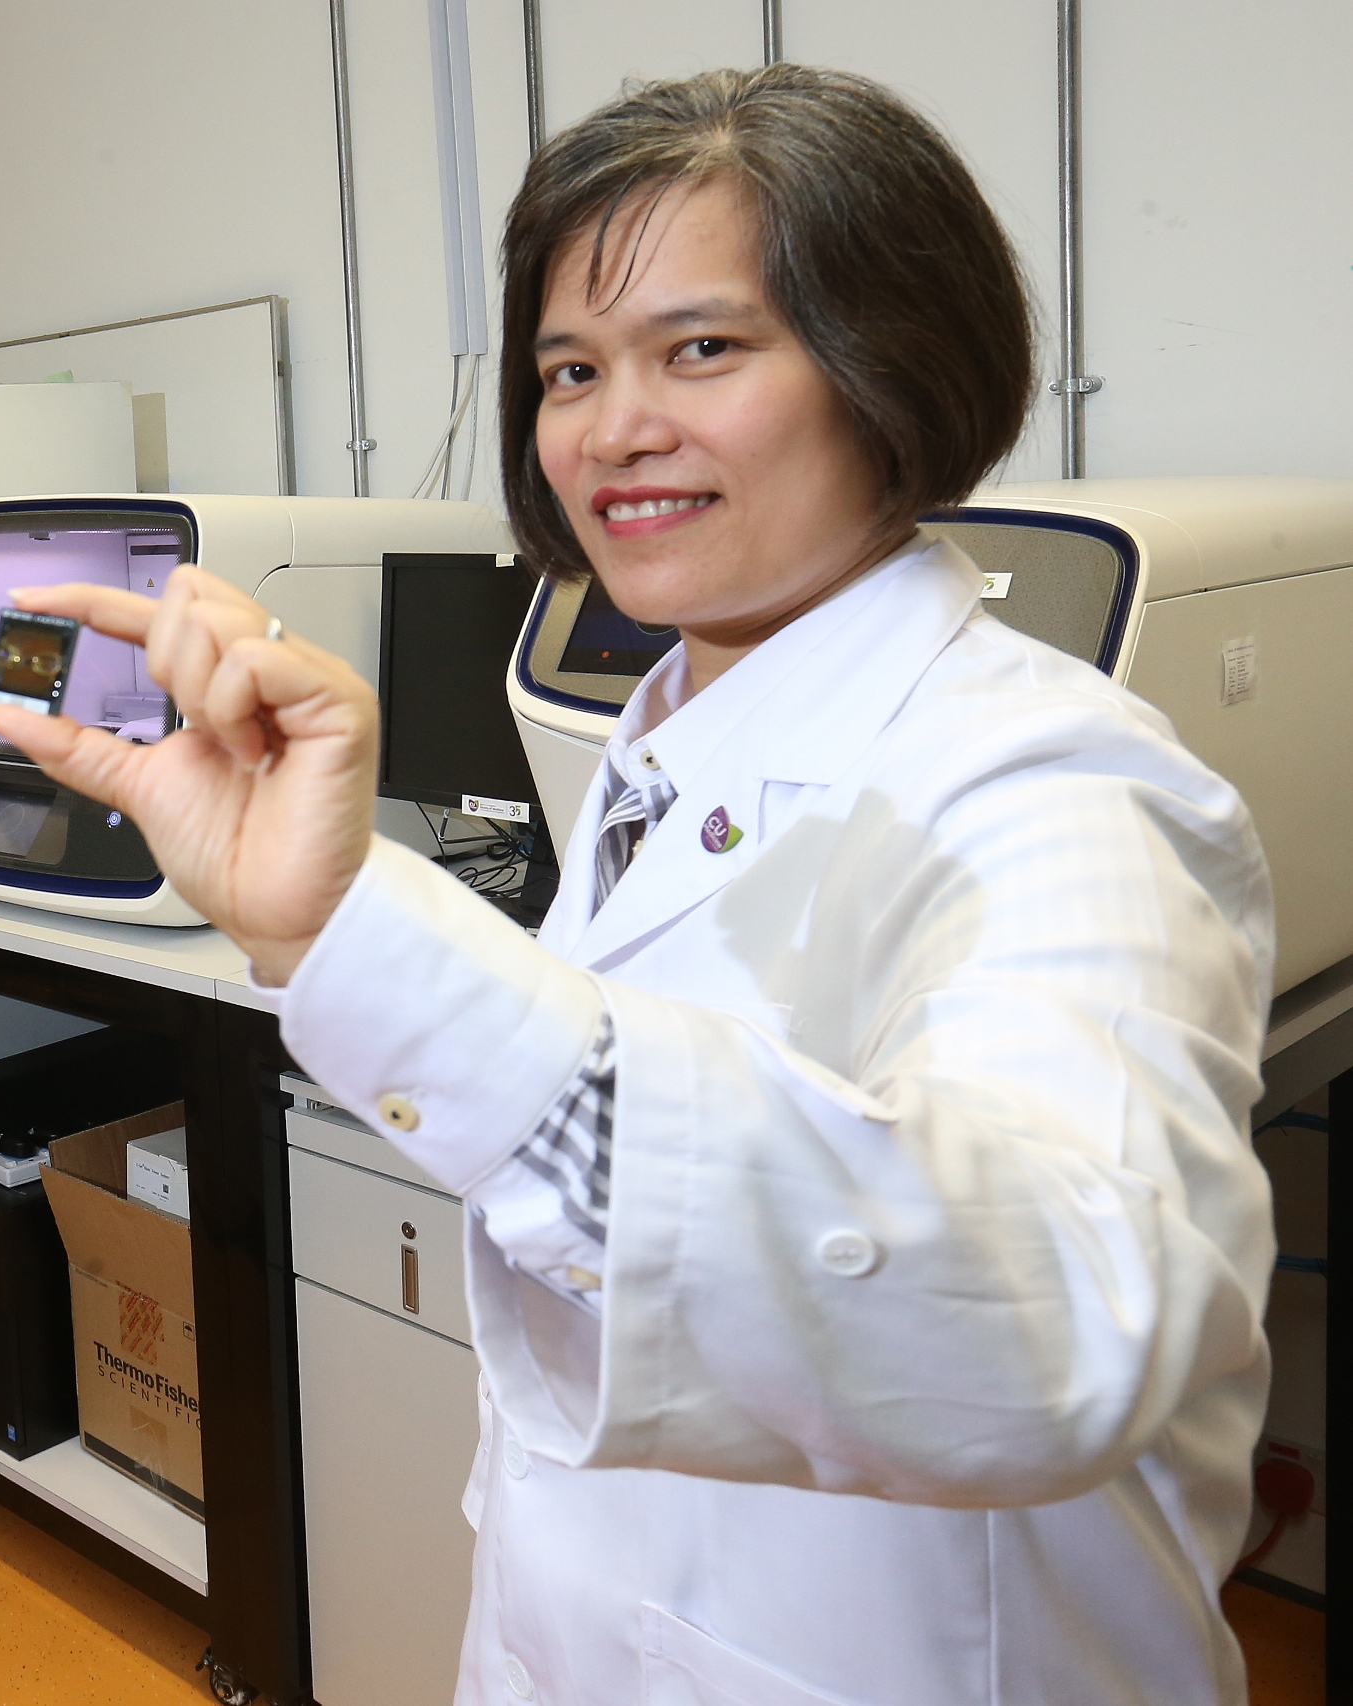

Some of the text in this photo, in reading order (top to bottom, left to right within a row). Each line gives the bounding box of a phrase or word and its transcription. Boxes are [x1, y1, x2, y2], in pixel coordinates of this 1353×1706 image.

[984, 578, 996, 590] 5
[509, 805, 521, 816] 35
[708, 816, 728, 836] CU
[93, 1340, 199, 1412] ThermoFishe
